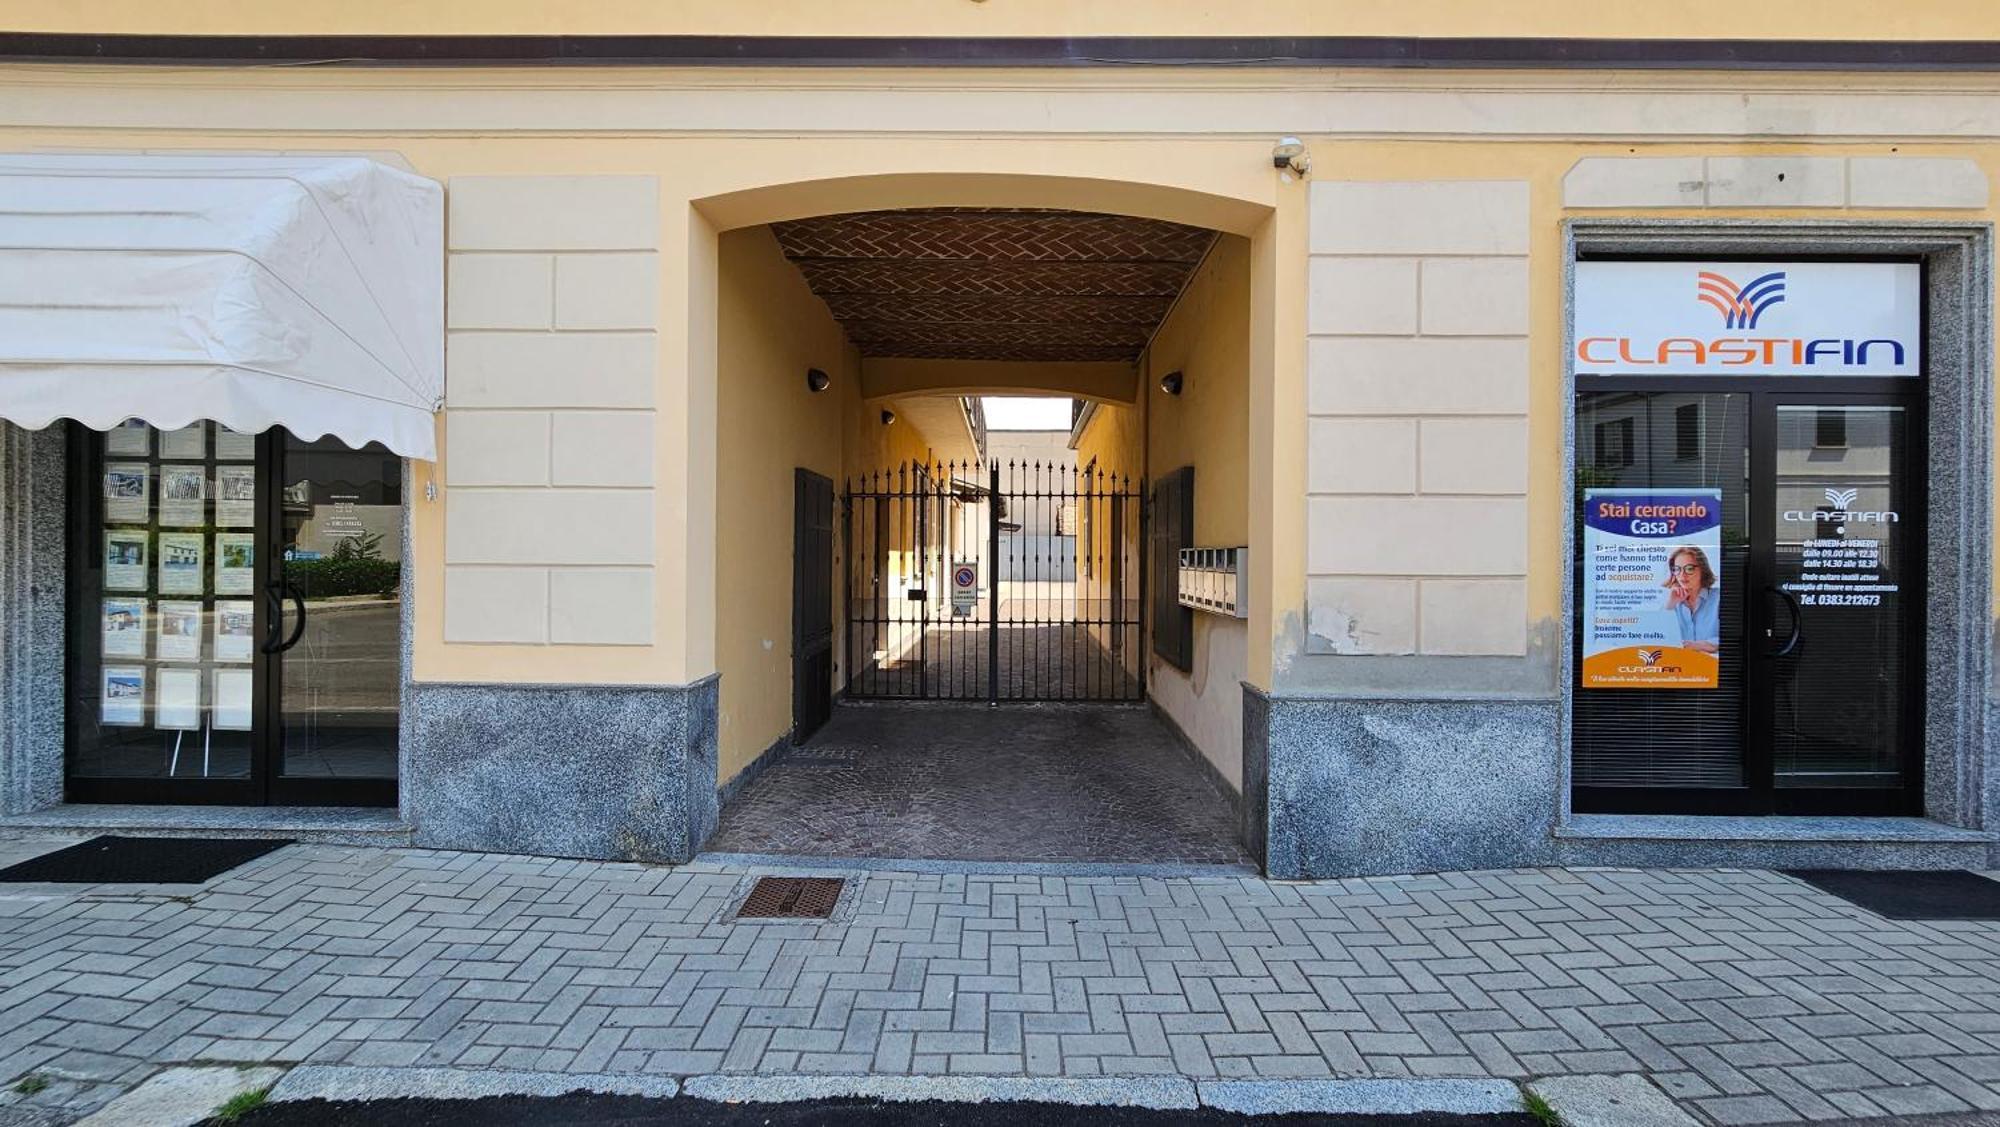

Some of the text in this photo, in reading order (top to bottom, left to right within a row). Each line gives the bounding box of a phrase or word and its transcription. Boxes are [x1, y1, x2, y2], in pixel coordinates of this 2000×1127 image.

[1577, 337, 1905, 365] CLASTIFIN
[1599, 501, 1706, 518] Stai cercando
[1783, 510, 1899, 522] CLASTIFIN
[1630, 519, 1677, 534] Casa?
[1619, 553, 1646, 562] hanno
[1595, 564, 1652, 573] certe persone
[1595, 572, 1654, 583] ad acquistare?
[1800, 594, 1881, 606] Tel. 0383.212673
